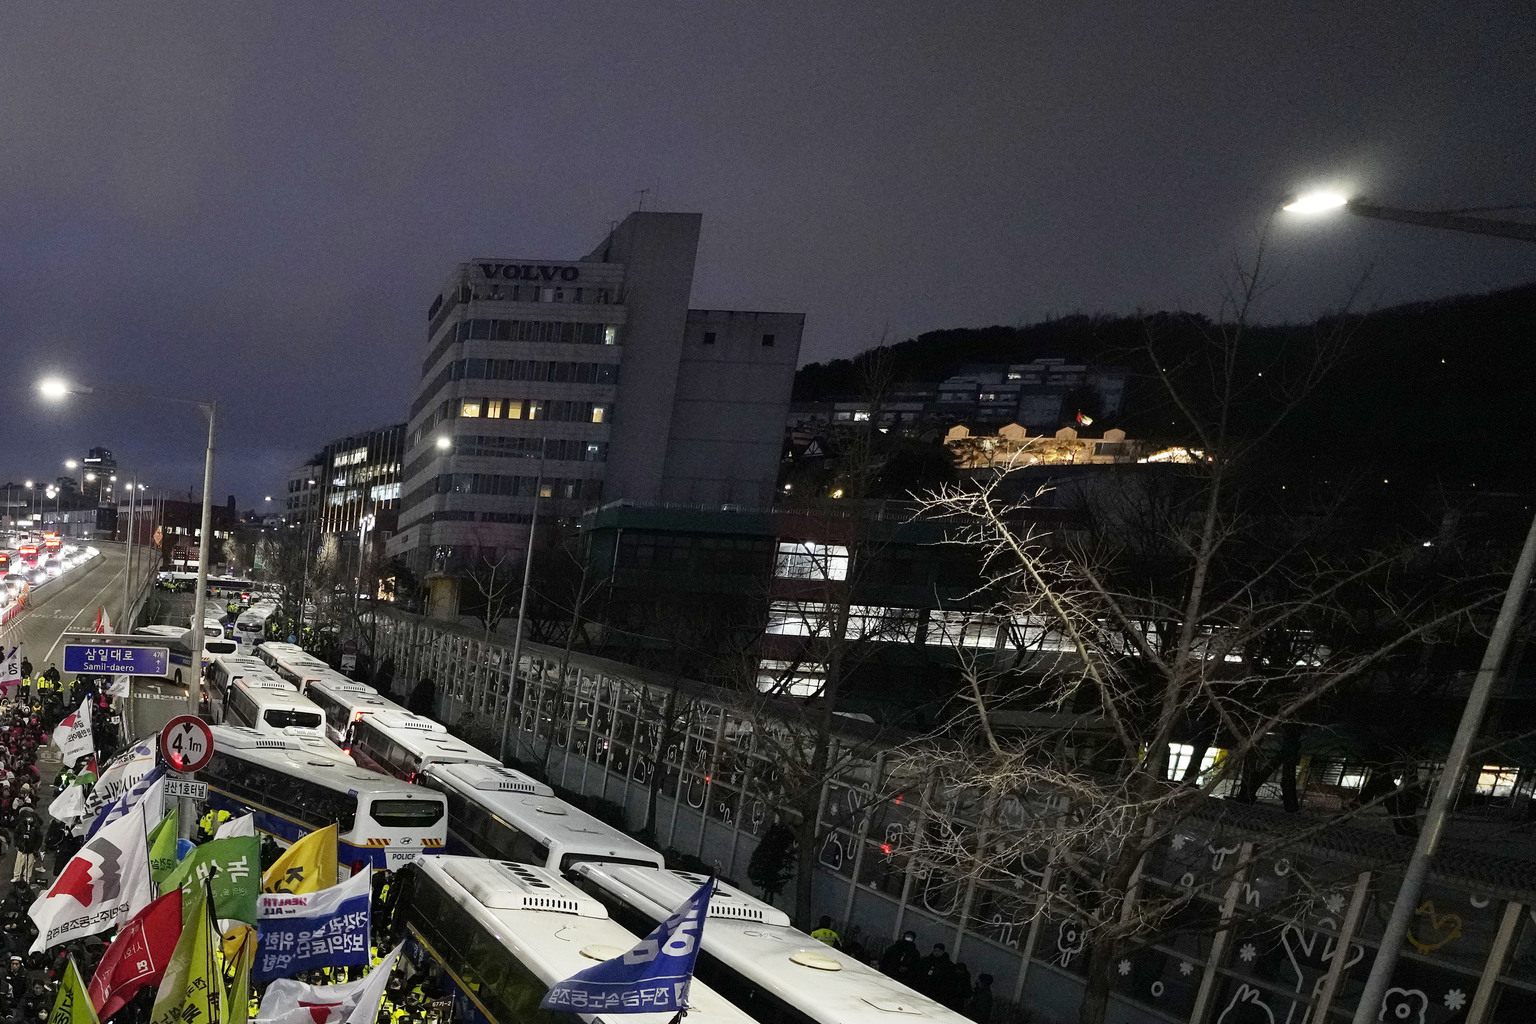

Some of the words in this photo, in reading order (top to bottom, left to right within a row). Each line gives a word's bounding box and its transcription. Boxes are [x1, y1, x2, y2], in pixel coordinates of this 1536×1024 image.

[478, 263, 580, 282] VOLVO
[85, 649, 134, 662] 삼일대로
[152, 651, 164, 659] 476
[83, 662, 135, 672] Samil-daero
[172, 732, 202, 753] 4.1m
